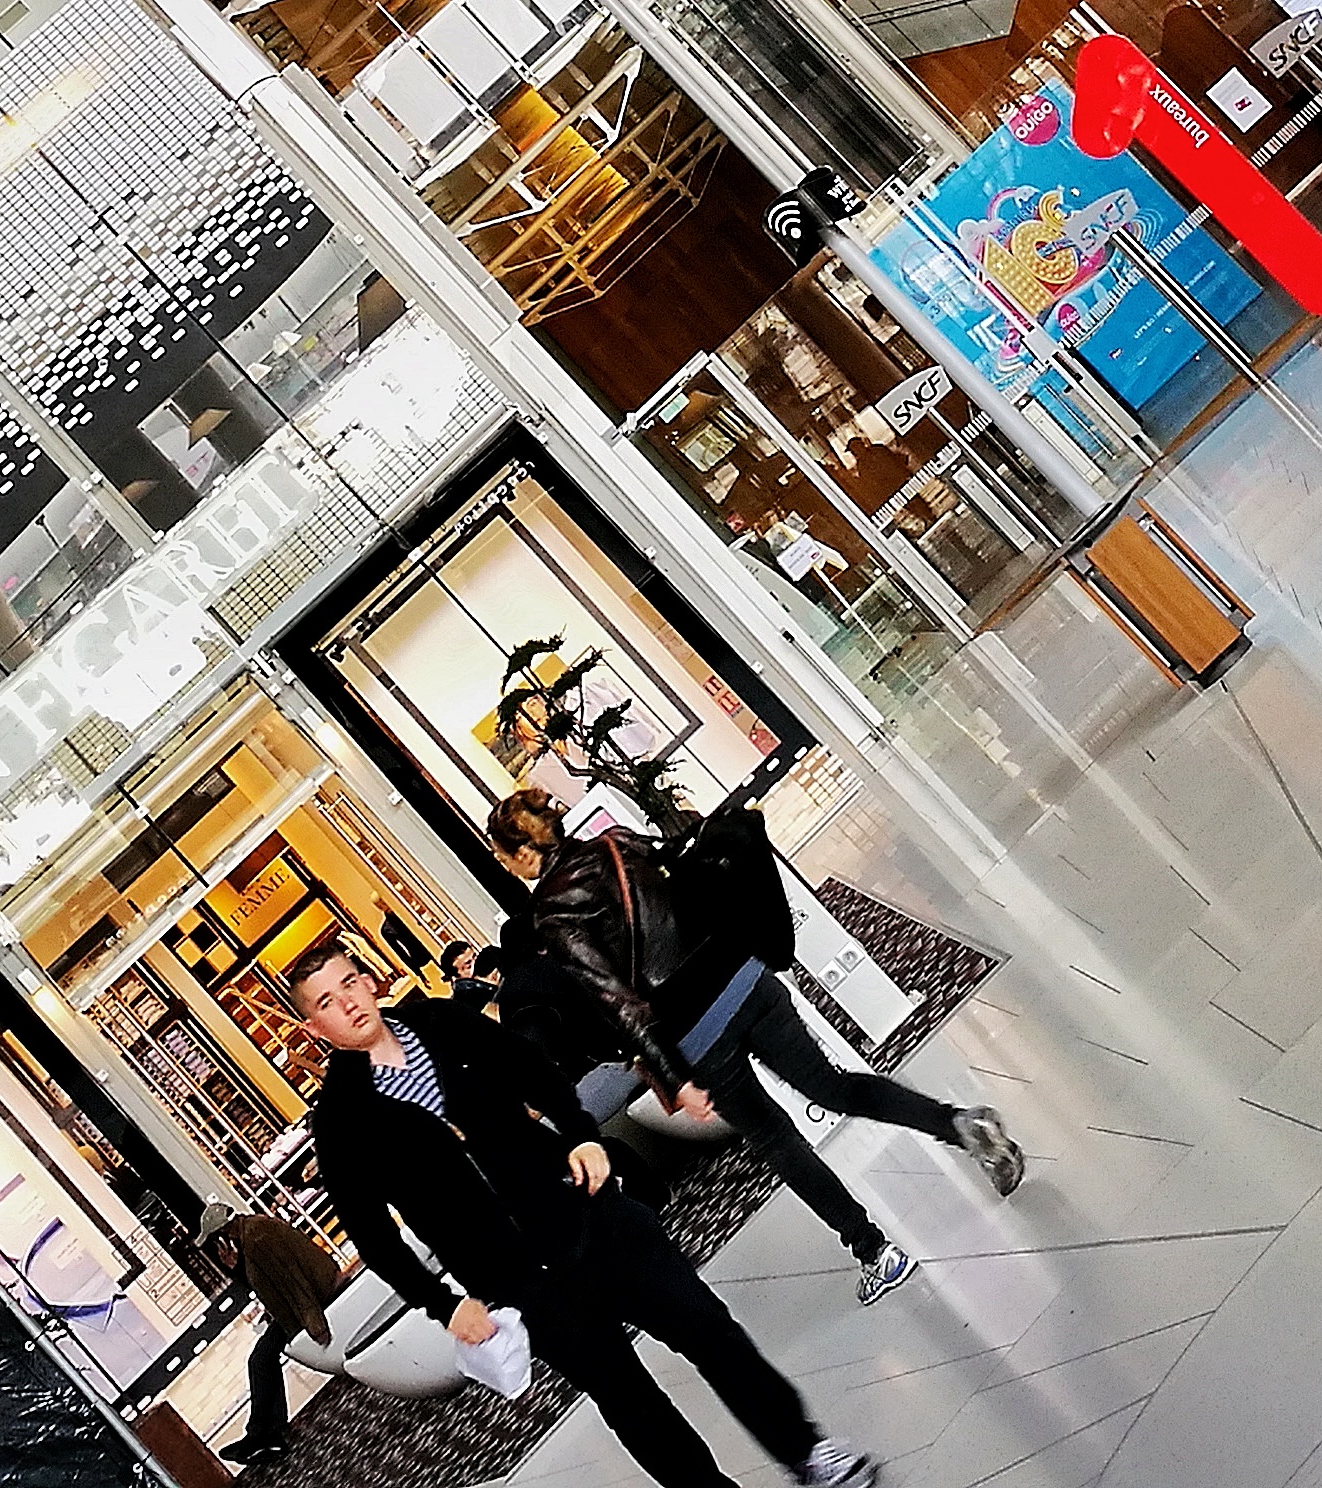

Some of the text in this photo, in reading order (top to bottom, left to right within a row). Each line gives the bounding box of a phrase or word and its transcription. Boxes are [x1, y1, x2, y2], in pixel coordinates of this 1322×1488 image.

[1147, 82, 1210, 149] bureaux
[889, 370, 947, 427] SNCF
[0, 452, 317, 751] FIGARET
[229, 866, 291, 926] FEMME
